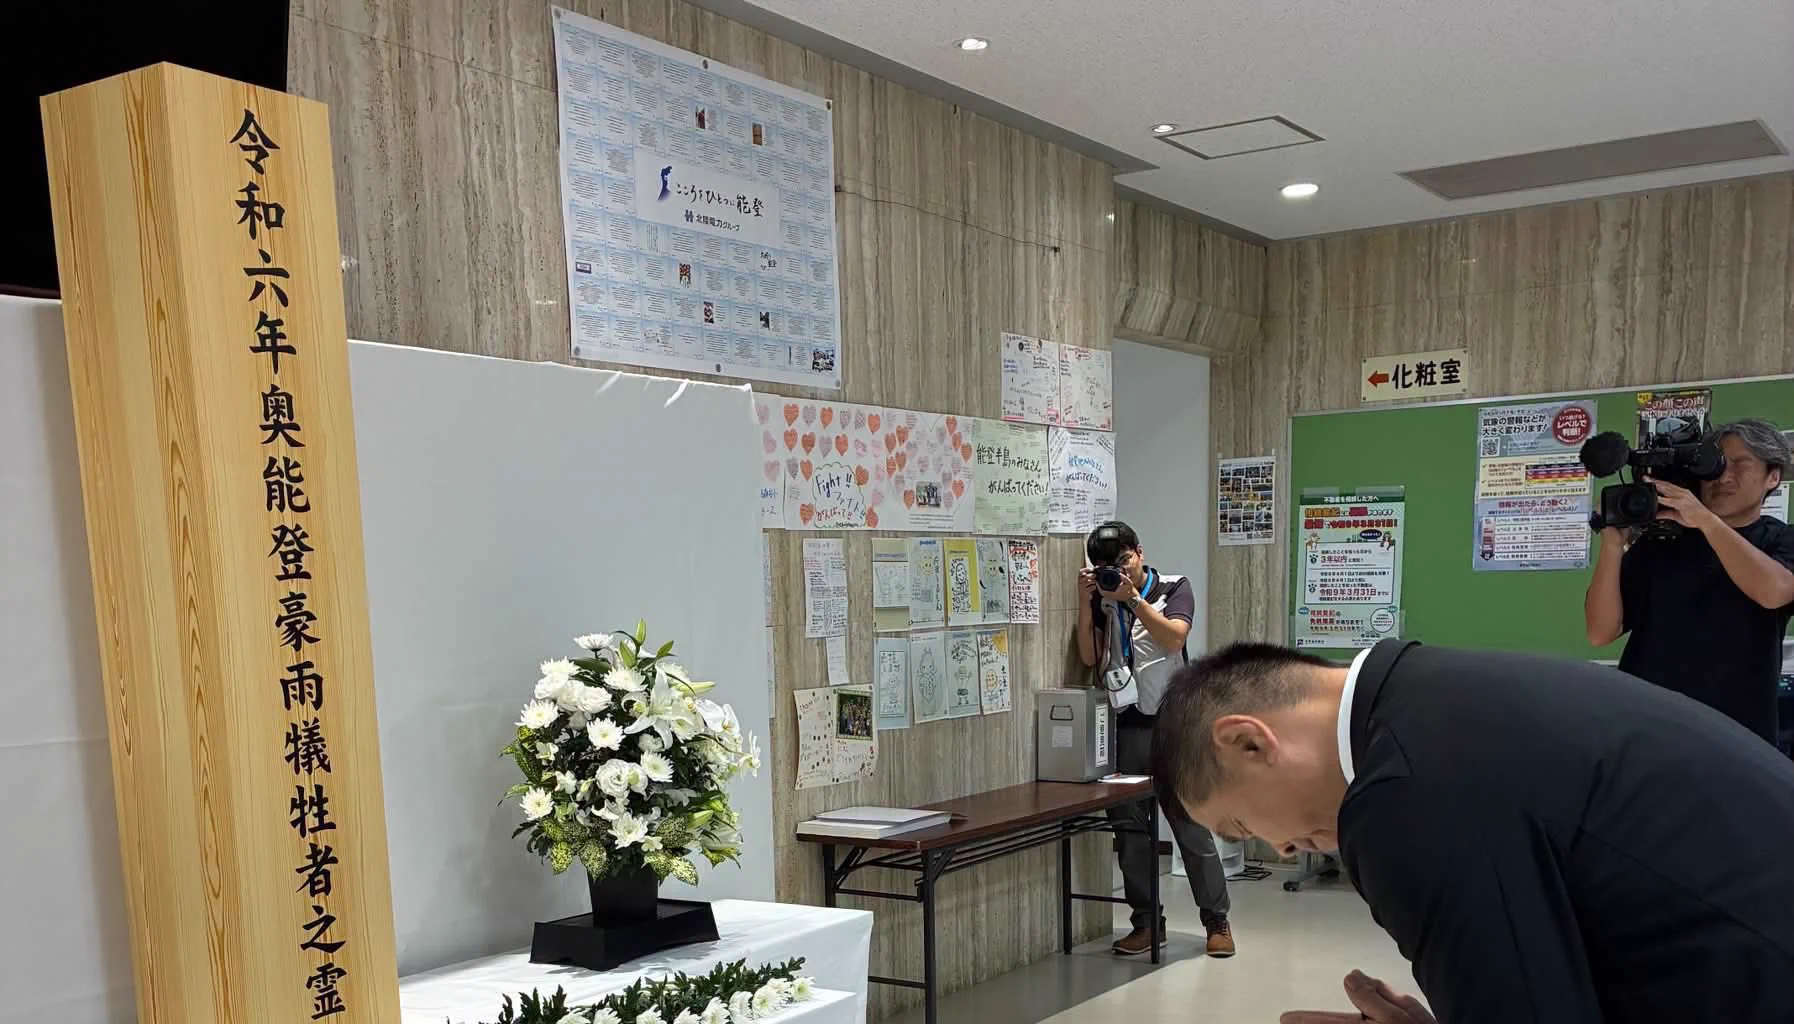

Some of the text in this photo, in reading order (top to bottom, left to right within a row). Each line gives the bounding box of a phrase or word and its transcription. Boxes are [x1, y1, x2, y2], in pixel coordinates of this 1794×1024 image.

[695, 213, 740, 231] 北陸電力グループ
[1391, 358, 1461, 390] 化粧室
[230, 108, 347, 1020] 令和六年奥能登豪雨犠牲者之霊
